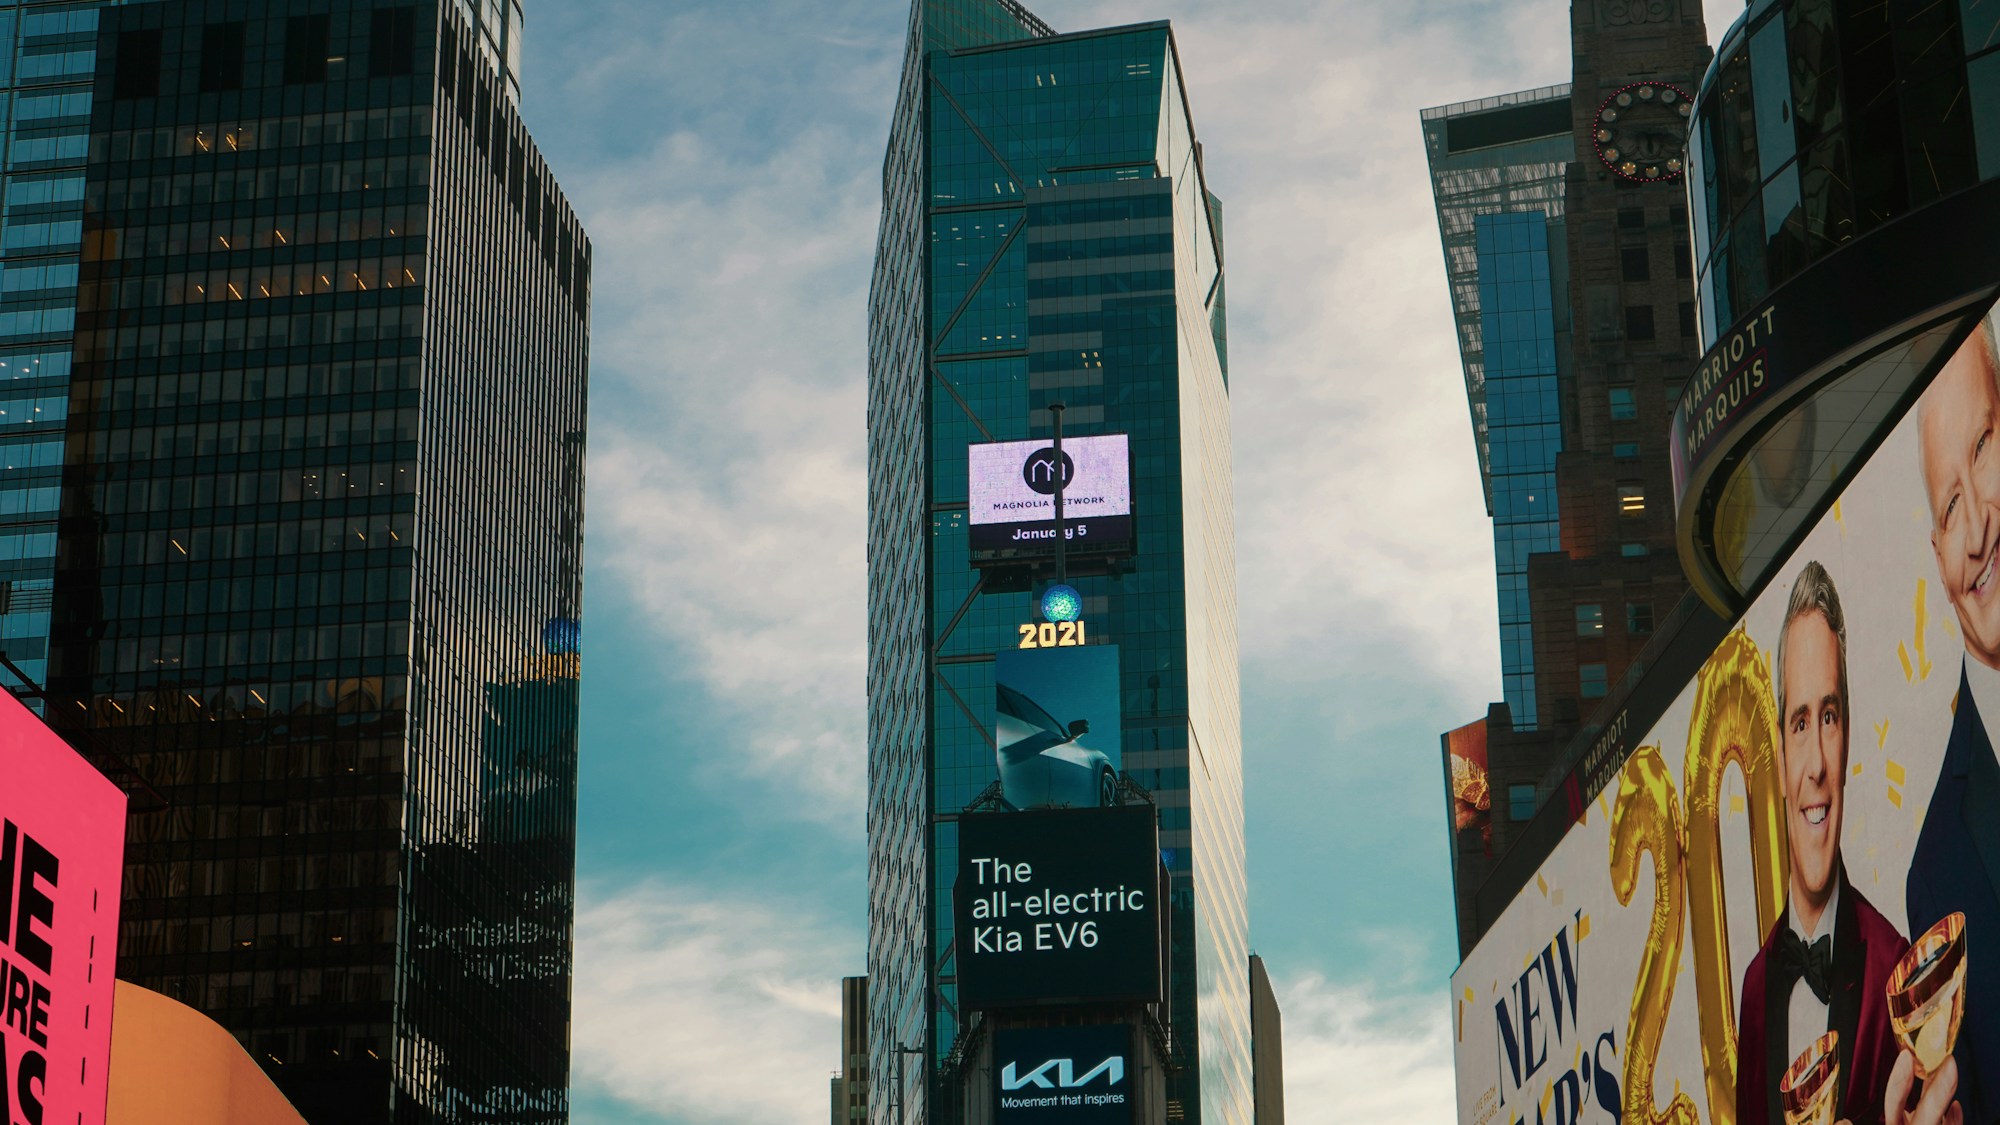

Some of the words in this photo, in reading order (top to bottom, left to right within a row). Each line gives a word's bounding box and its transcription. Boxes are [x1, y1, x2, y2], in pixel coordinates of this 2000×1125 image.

[1684, 305, 1775, 423] MARRIOTT
[1687, 358, 1764, 461] MARQUIS
[993, 500, 1050, 510] MAGNOLIA
[1053, 496, 1105, 506] ETWORK
[1012, 528, 1074, 540] Januay
[1077, 524, 1087, 536] 5
[1018, 620, 1086, 649] 2021
[1585, 709, 1628, 777] MARRIOTT
[1586, 745, 1625, 804] MARQUIS
[971, 857, 1032, 884] The
[972, 885, 1144, 919] all-electric
[974, 926, 1023, 953] Kia
[1035, 921, 1099, 950] EV6
[1495, 907, 1582, 1109] NEW
[1001, 1055, 1124, 1090] KIA
[1001, 1095, 1058, 1108] Movement
[1061, 1094, 1081, 1106] that
[1084, 1093, 1125, 1107] inspires
